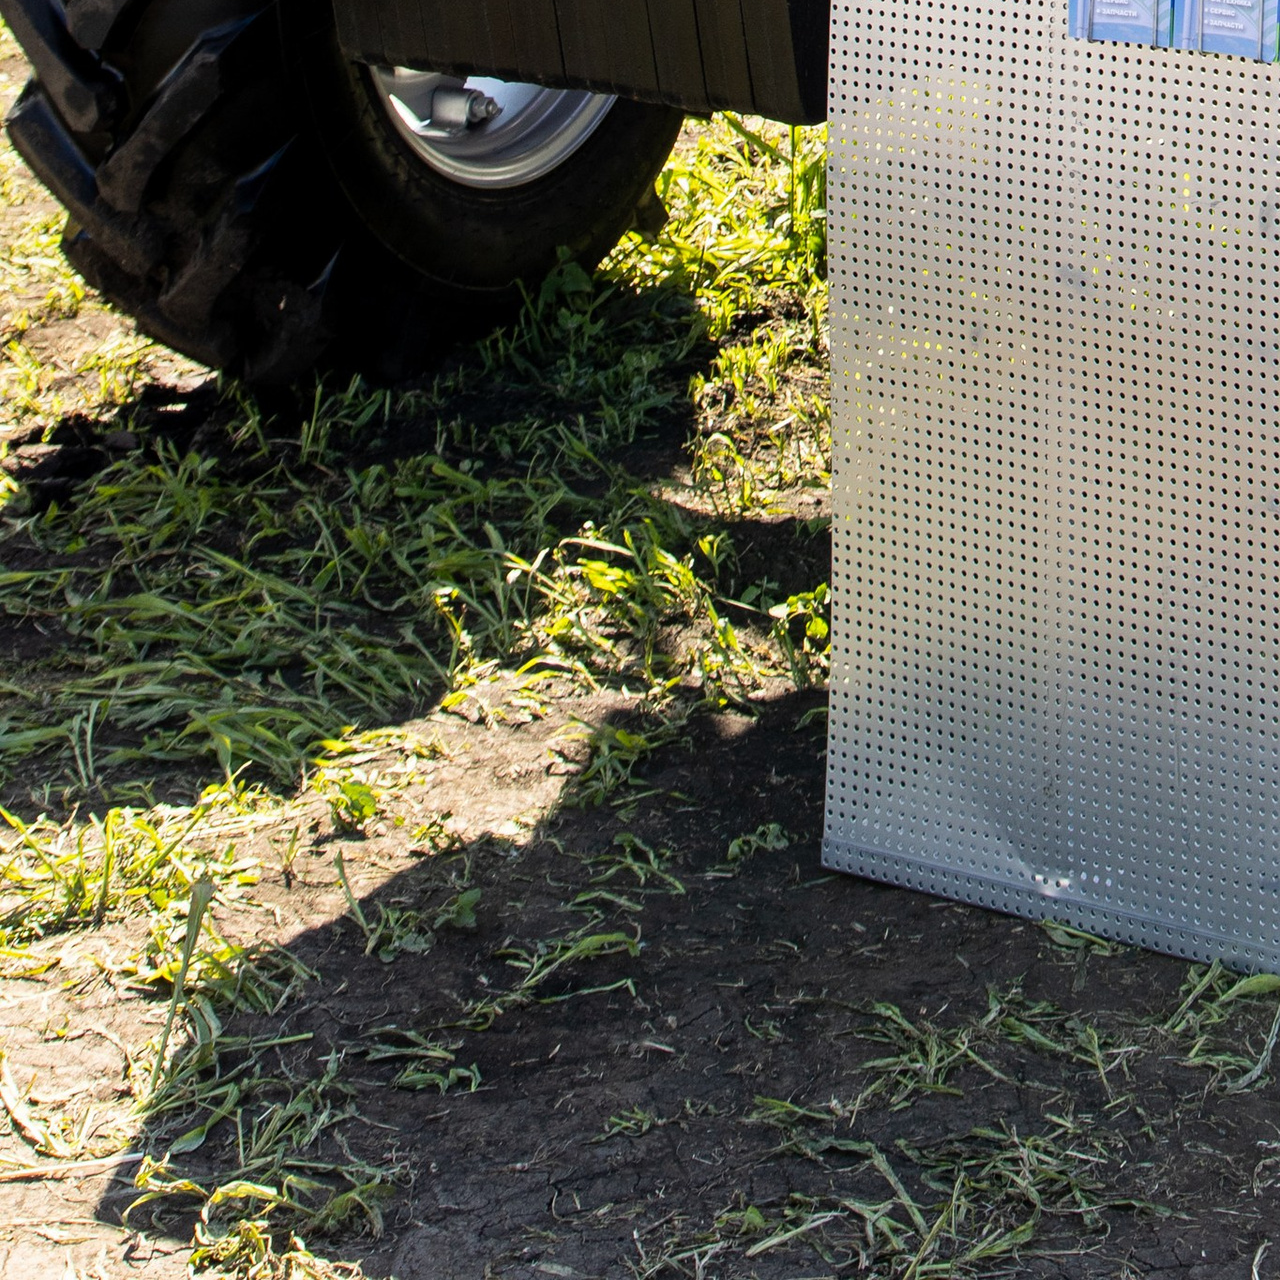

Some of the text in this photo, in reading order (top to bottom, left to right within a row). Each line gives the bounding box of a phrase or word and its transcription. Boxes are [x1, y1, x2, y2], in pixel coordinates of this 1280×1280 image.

[1102, 8, 1138, 17] ЗАПЧАСТИ
[1209, 8, 1235, 17] СЕРВИС
[1209, 19, 1244, 30] ЗАПЧАСТИ
